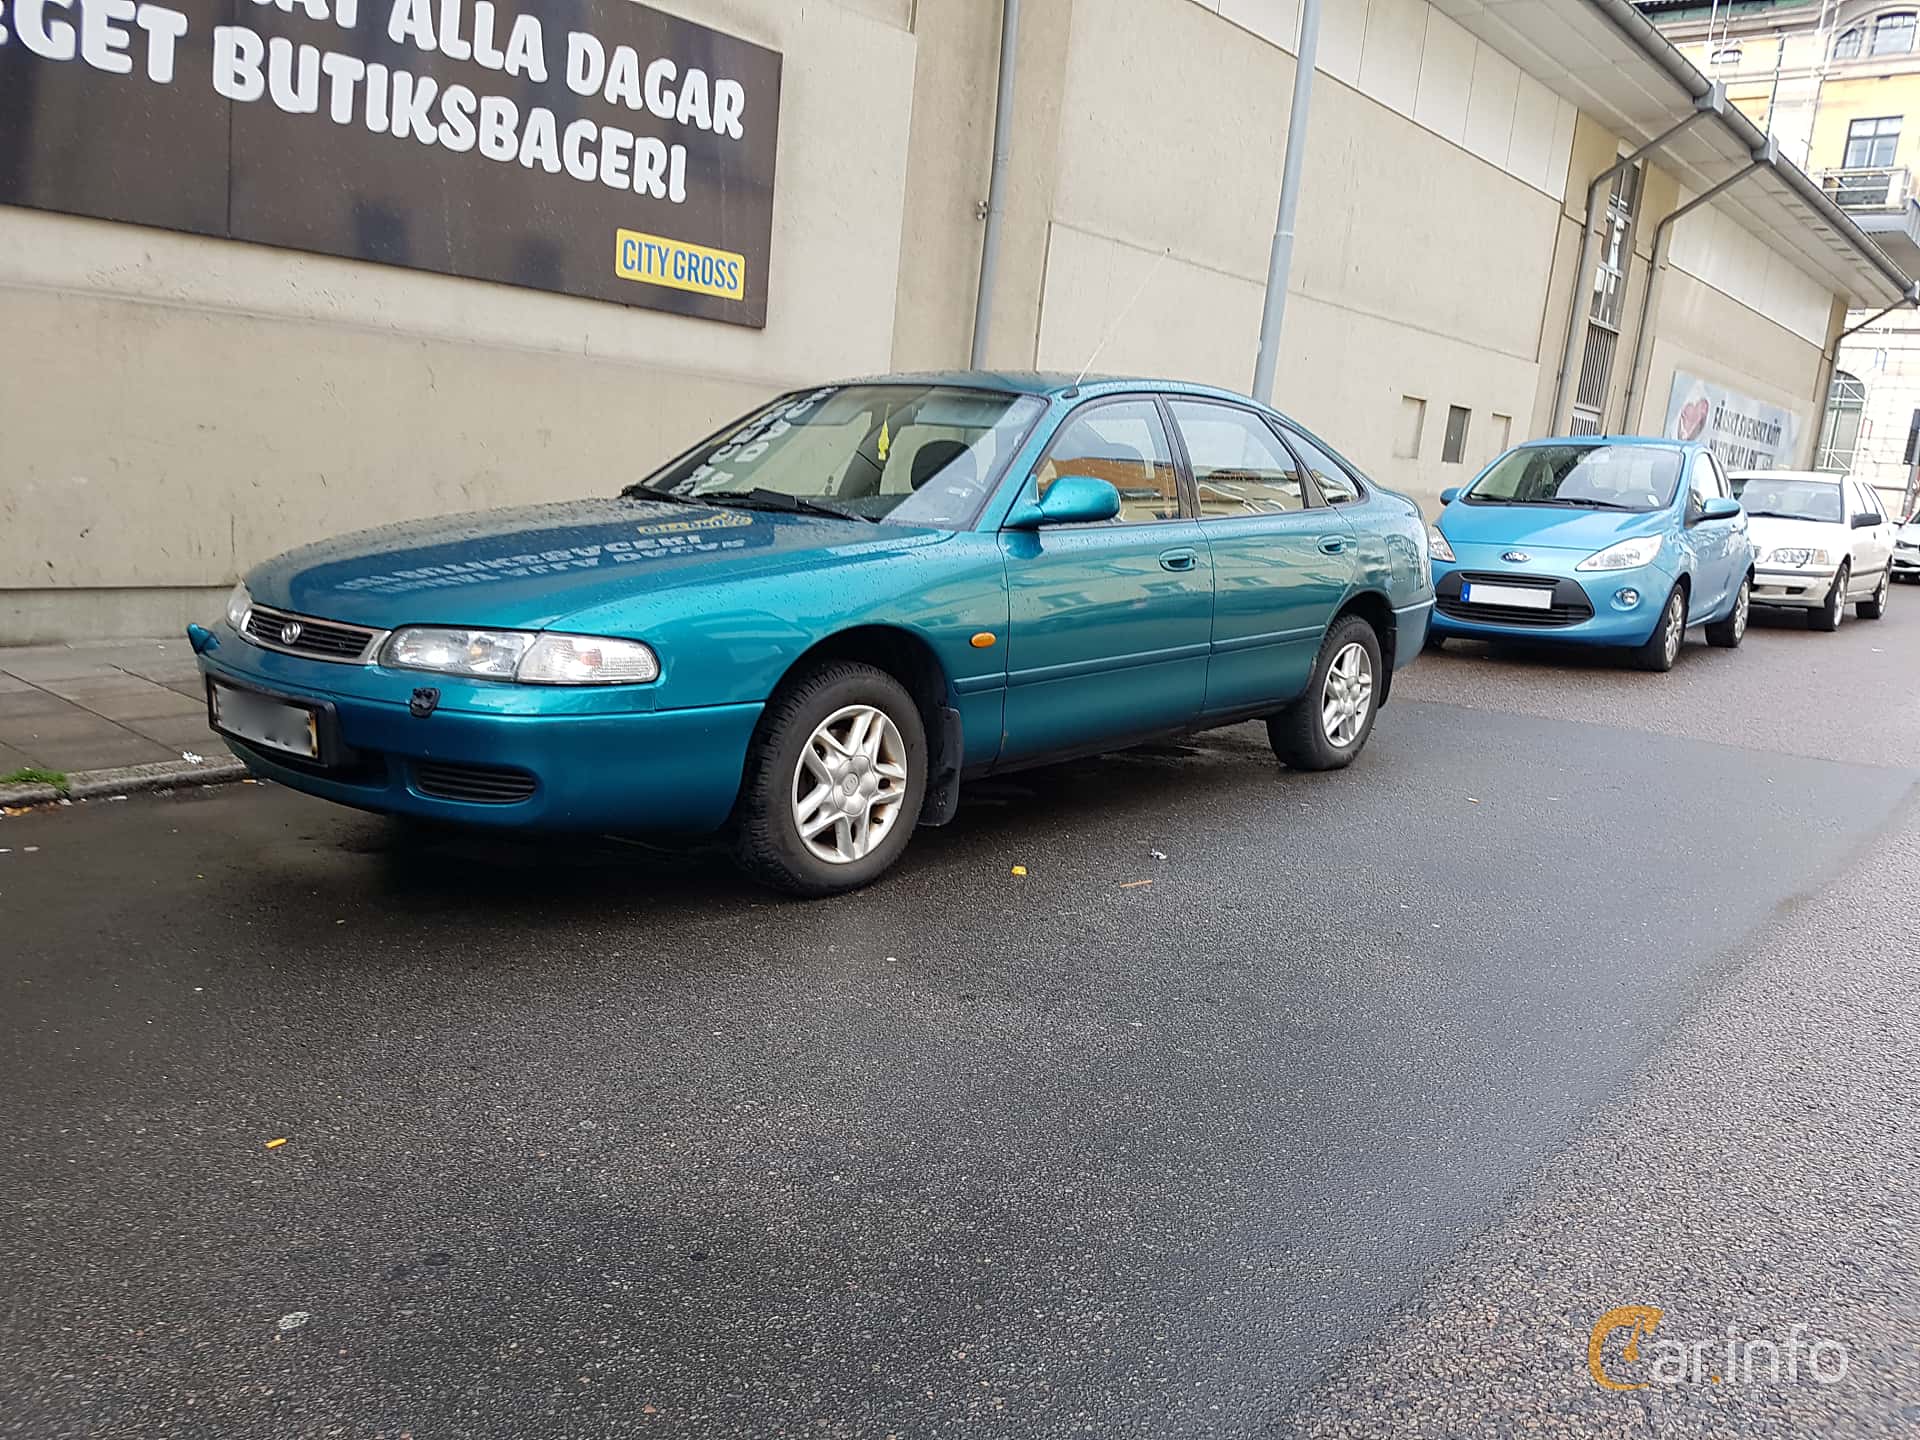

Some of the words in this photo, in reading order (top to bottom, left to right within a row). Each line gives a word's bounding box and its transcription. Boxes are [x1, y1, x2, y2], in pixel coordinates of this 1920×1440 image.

[0, 0, 188, 83] GET
[213, 27, 687, 203] BUTIKSBAGERI
[388, 0, 548, 82] ALLA
[567, 32, 745, 139] DAGAR
[623, 239, 670, 277] CITY
[673, 249, 738, 290] GROSS
